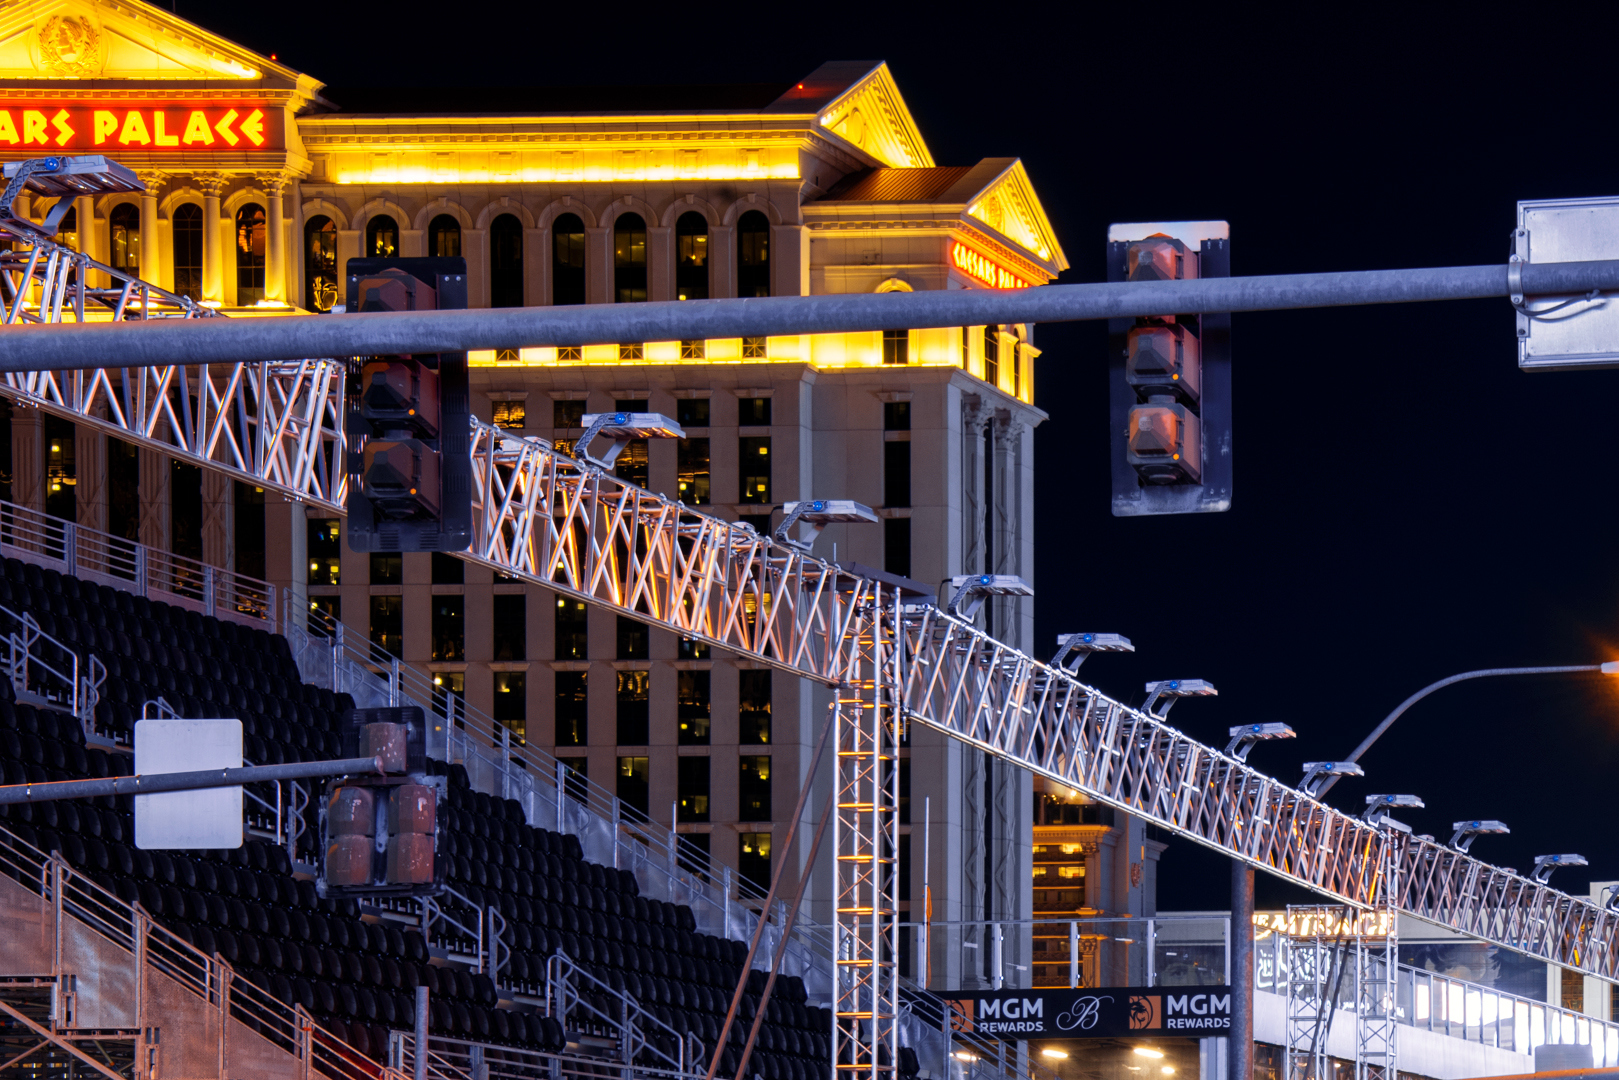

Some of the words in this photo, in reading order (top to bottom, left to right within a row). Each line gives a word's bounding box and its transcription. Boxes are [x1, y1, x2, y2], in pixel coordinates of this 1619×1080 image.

[94, 108, 265, 147] PALACE
[953, 242, 996, 288] CAESARS
[980, 998, 1044, 1018] MGM
[1167, 994, 1231, 1015] MGM
[979, 1021, 1044, 1033] REWARDS
[1167, 1017, 1231, 1029] REWARDS
